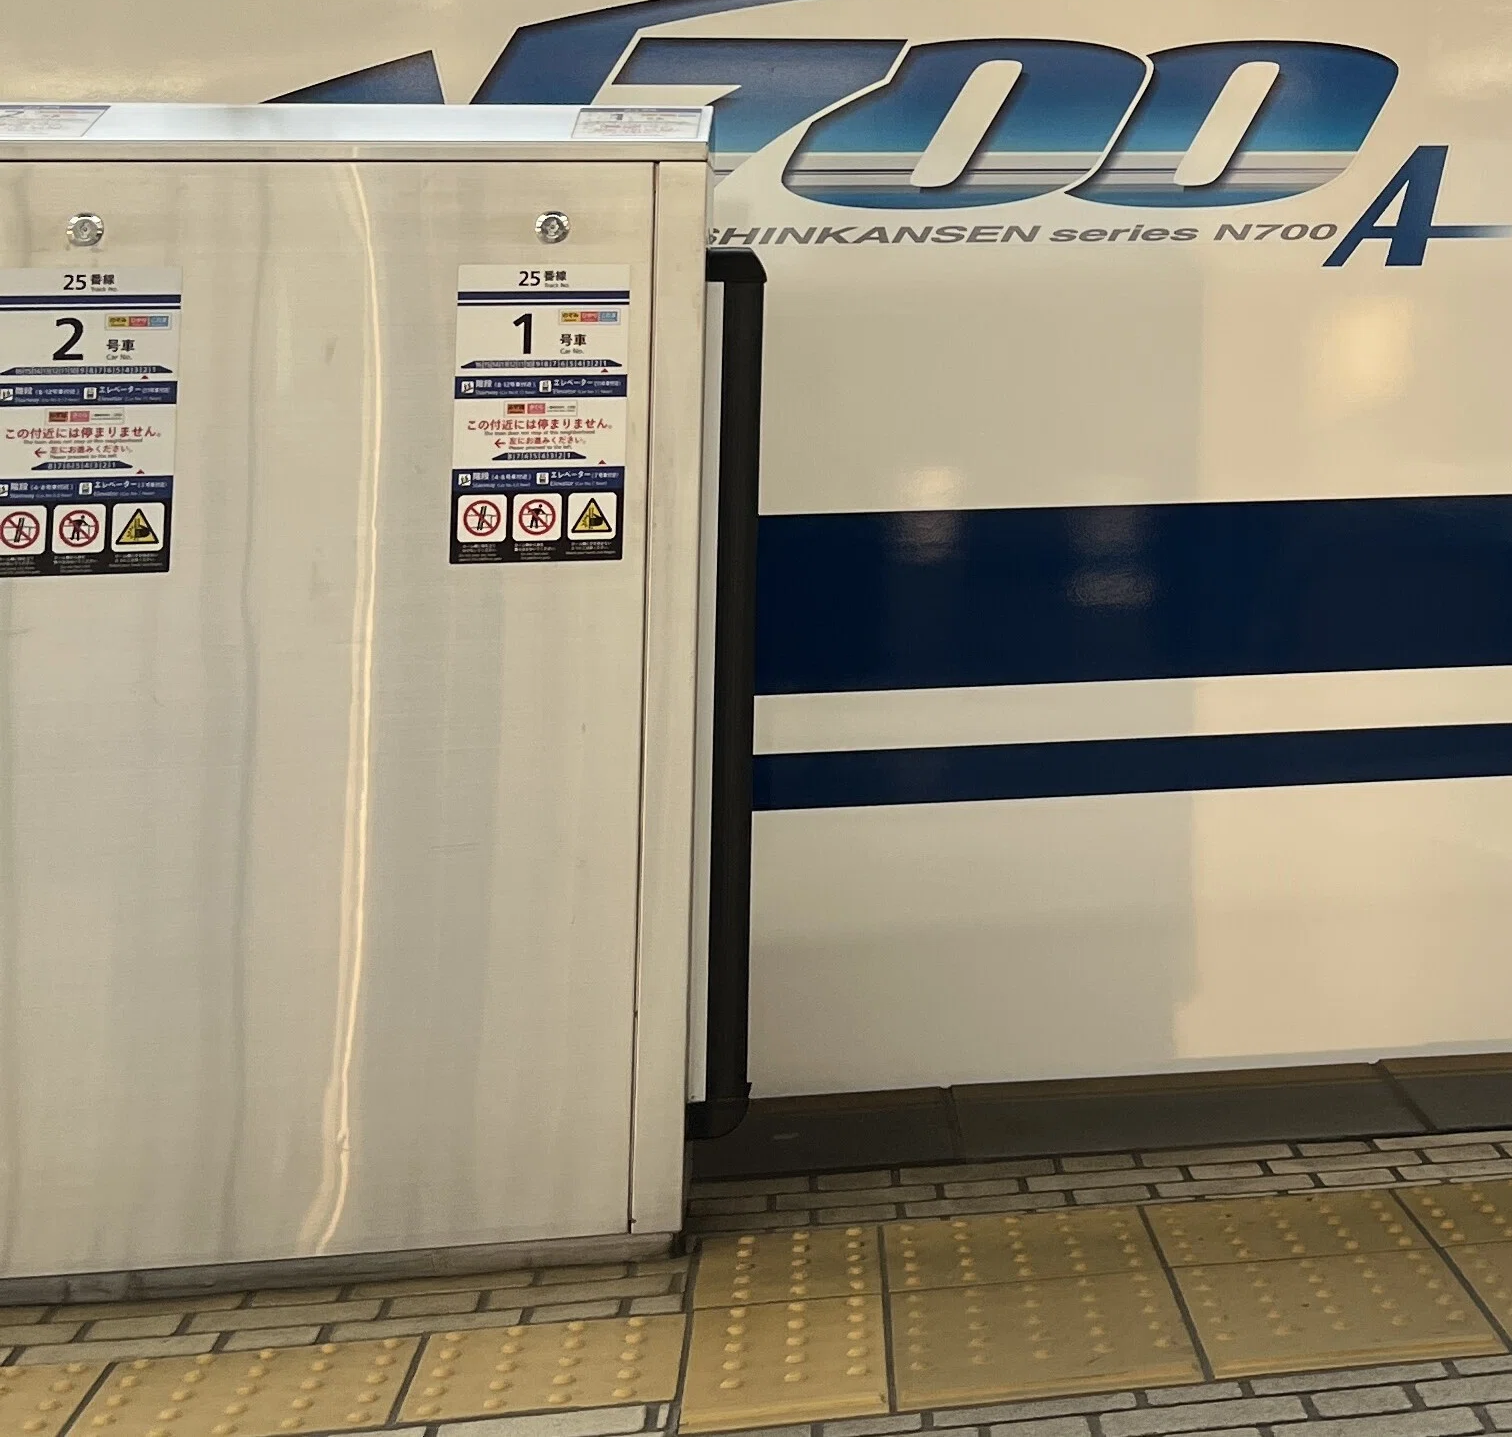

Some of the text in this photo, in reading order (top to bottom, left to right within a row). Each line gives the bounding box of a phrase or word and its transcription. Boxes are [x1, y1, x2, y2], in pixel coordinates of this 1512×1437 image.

[1323, 145, 1456, 267] A
[709, 222, 1338, 246] HINKANSEN series N700
[63, 274, 87, 291] 25
[518, 270, 567, 287] 25 番線
[52, 317, 135, 361] 2 号車
[513, 313, 587, 355] 1 号車
[5, 425, 162, 440] この付近には停まりません。
[467, 418, 613, 431] この付近には停まりません。
[509, 436, 587, 445] 左にお進みください。
